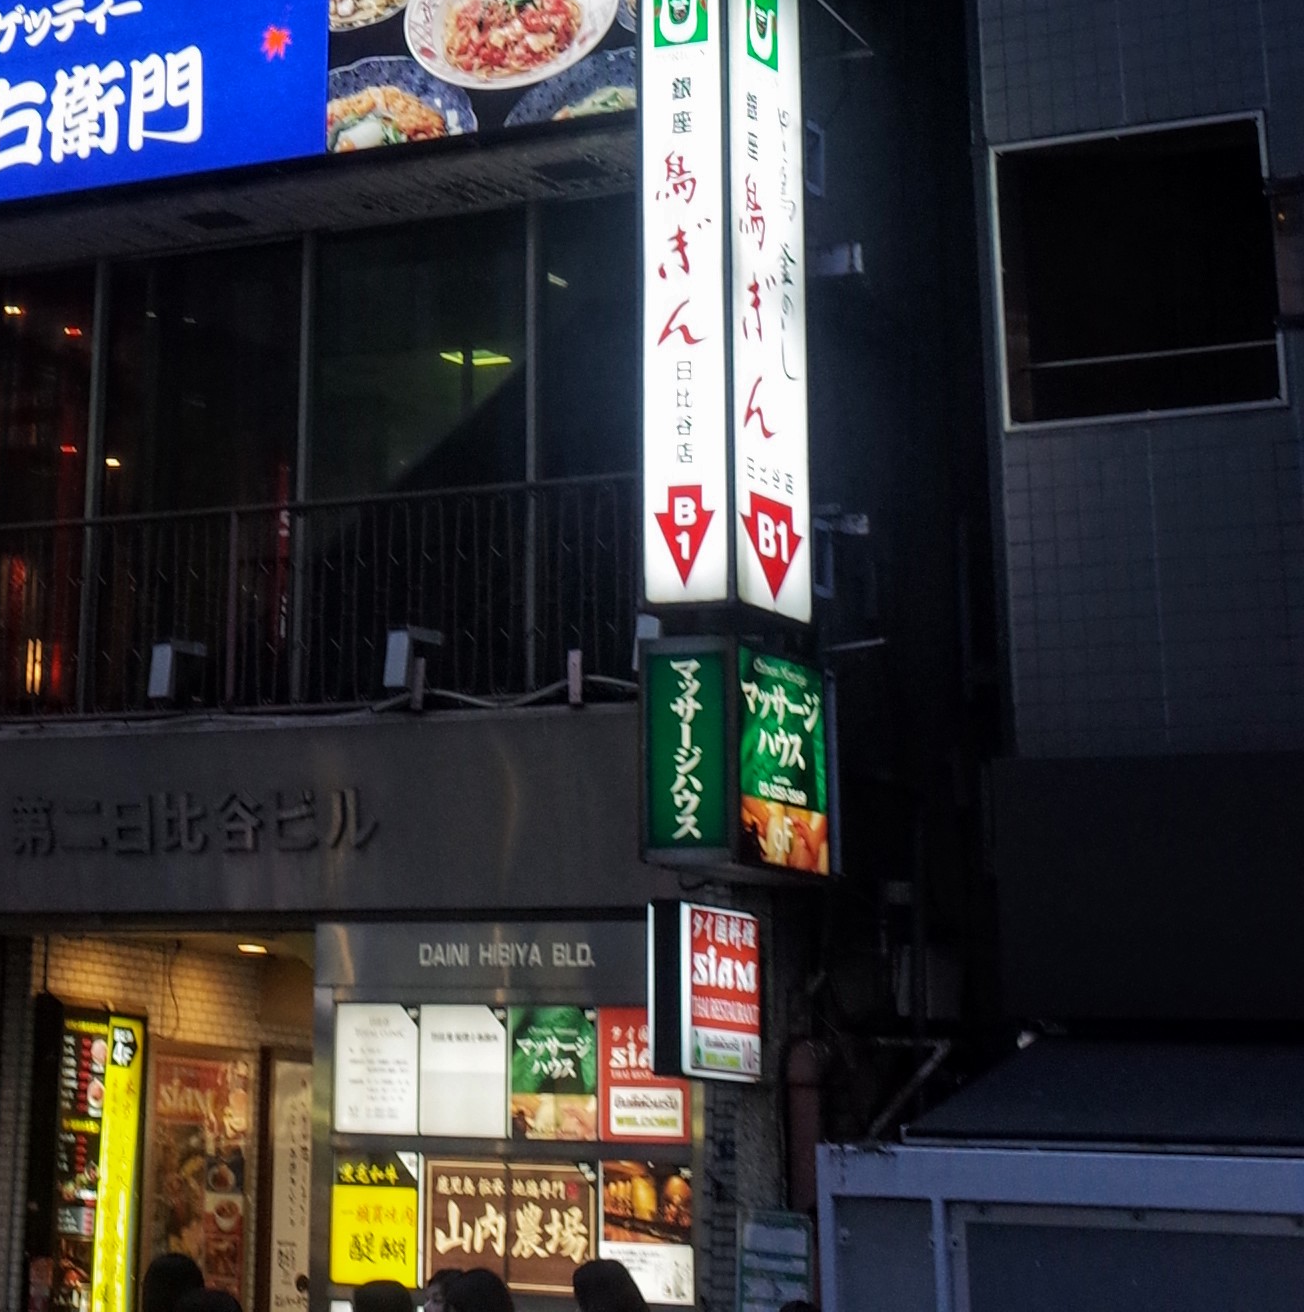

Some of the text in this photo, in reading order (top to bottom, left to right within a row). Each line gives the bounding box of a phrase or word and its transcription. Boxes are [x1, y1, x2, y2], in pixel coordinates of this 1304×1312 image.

[756, 510, 791, 565] B1
[740, 678, 821, 734] マッサージ
[669, 658, 704, 841] マッサージハウス
[756, 726, 807, 771] ハウス
[12, 787, 380, 859] 第二日比谷ビル
[418, 942, 596, 968] DAINI HIBIYA BLD.
[434, 1198, 589, 1265] 山内農場
